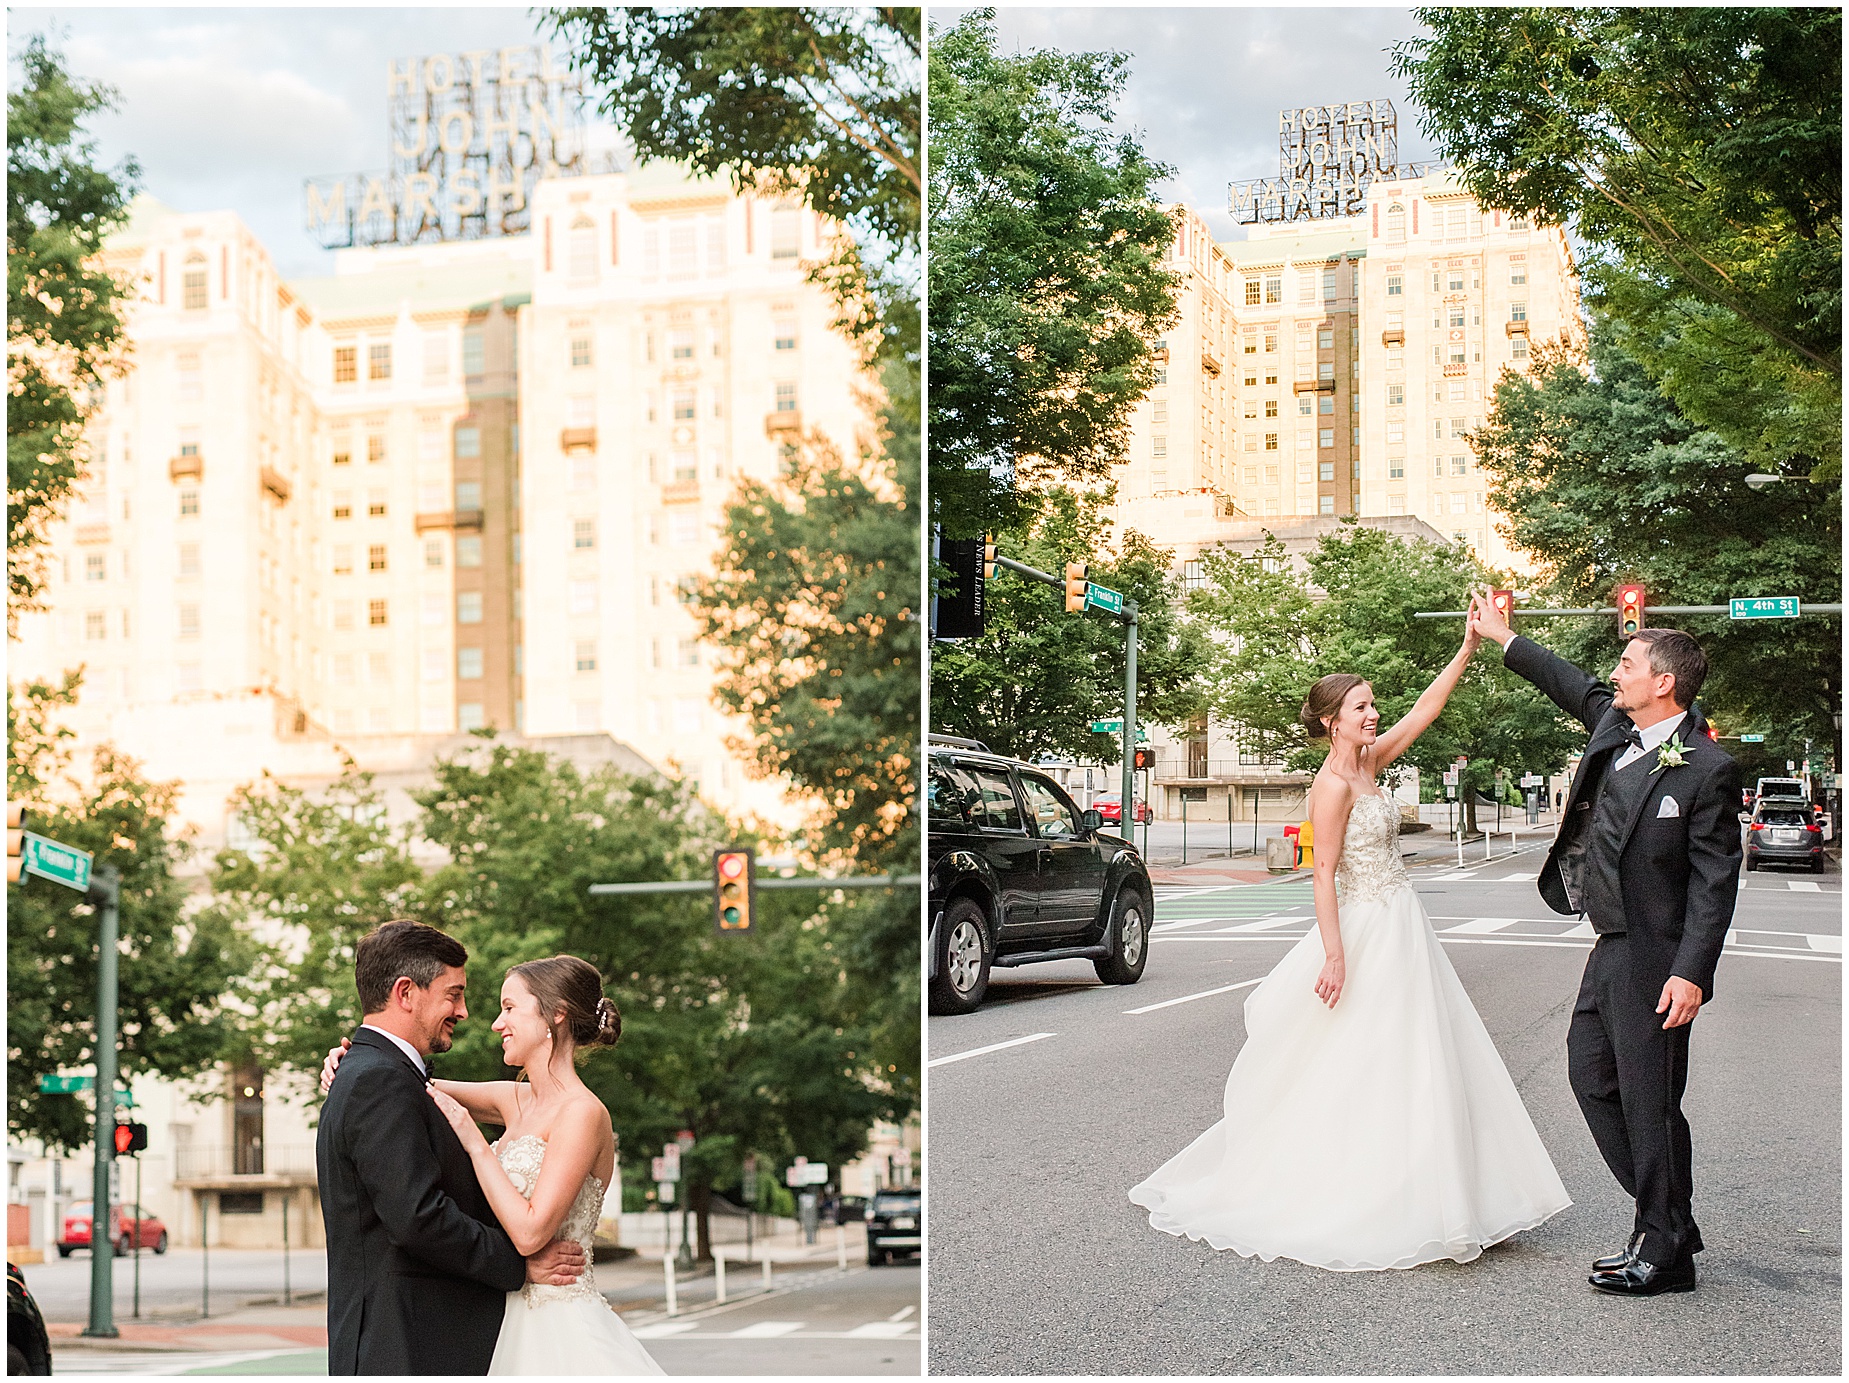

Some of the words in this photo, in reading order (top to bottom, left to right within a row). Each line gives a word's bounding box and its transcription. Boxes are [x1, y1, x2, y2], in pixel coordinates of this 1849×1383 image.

[387, 45, 570, 96] HOTEL
[395, 98, 565, 158] JOHN
[1279, 99, 1389, 133] HOTEL
[1282, 132, 1385, 169] JOHN
[975, 544, 985, 574] NEWS
[974, 576, 984, 616] LEADER
[1094, 587, 1114, 603] Franklin
[1114, 595, 1120, 605] St
[1735, 601, 1748, 611] N.
[1752, 600, 1775, 610] 4th
[1779, 599, 1793, 609] St
